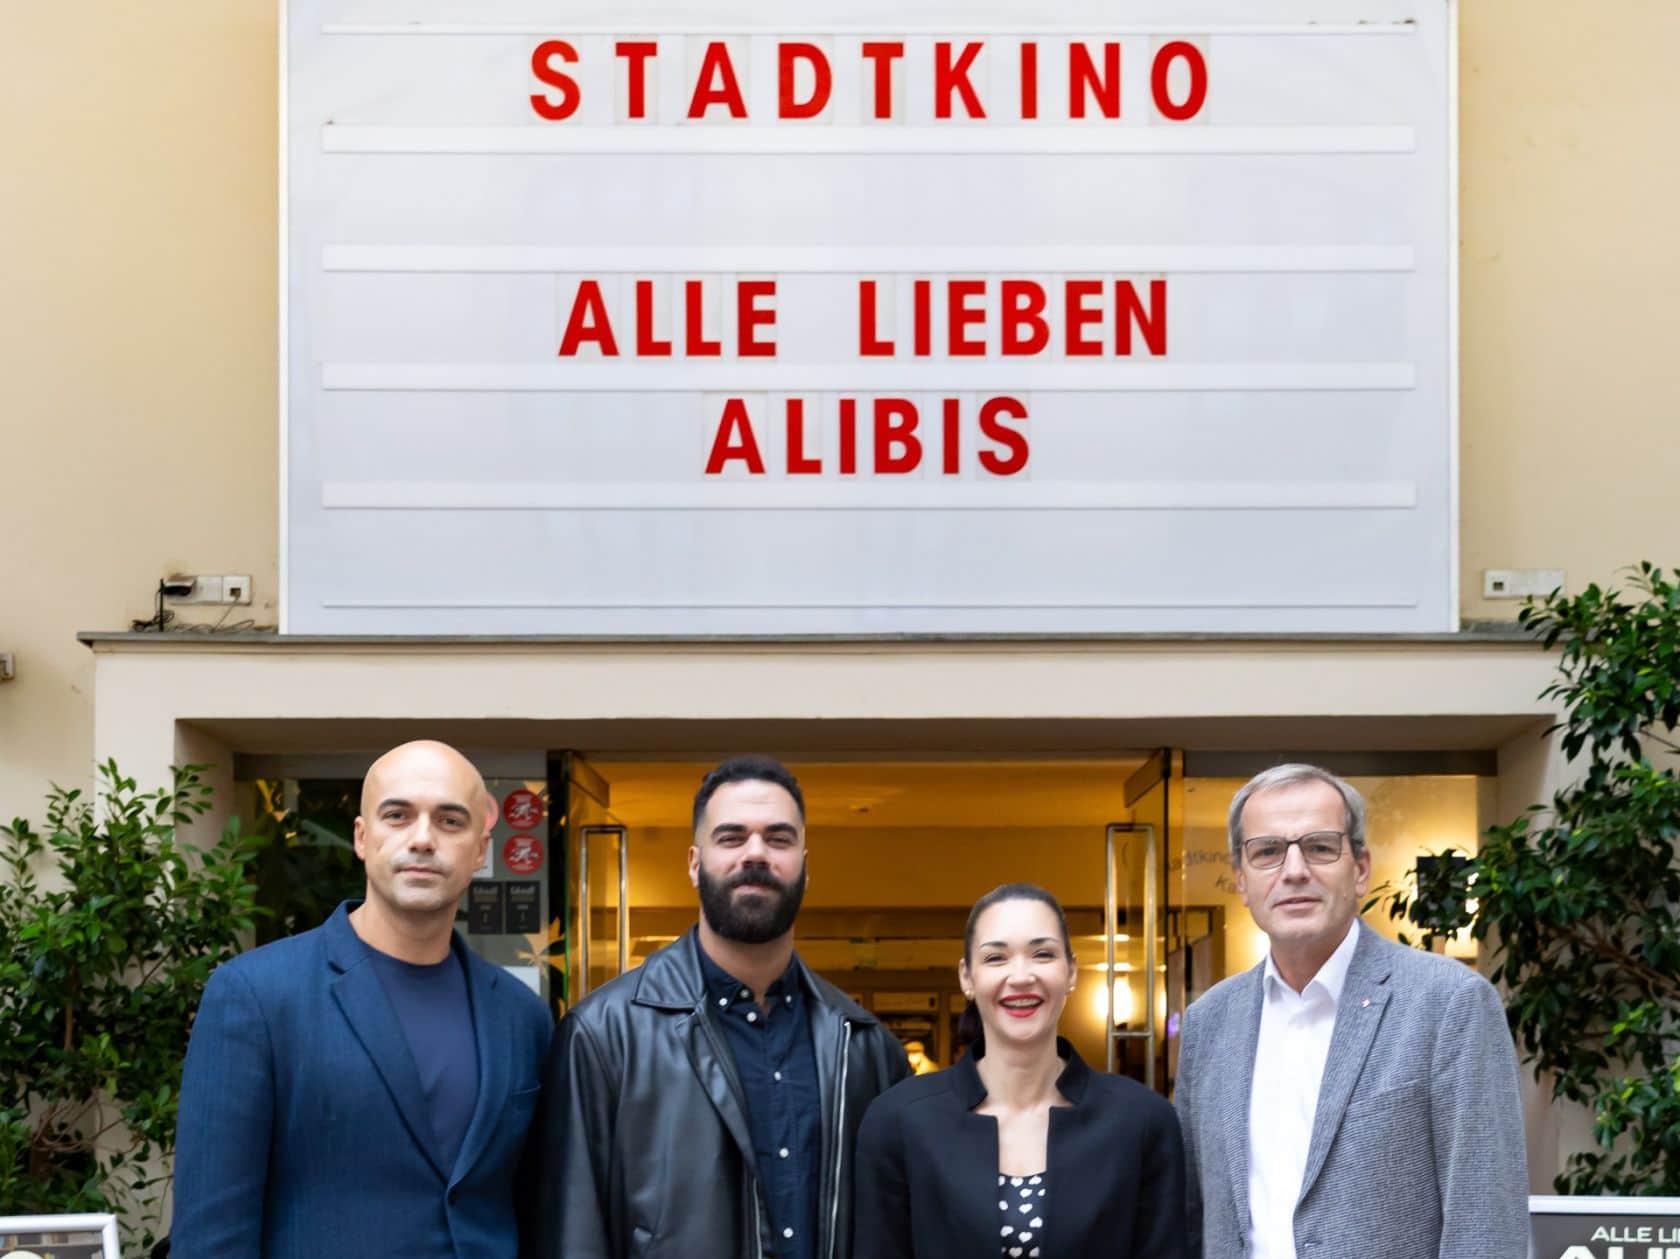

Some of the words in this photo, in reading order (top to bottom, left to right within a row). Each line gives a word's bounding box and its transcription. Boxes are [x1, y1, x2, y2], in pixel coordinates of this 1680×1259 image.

[530, 40, 1208, 121] STADTKINO
[559, 279, 777, 357] ALLE
[859, 279, 1168, 357] LIEBEN
[705, 396, 1030, 477] ALIBIS
[1590, 1226, 1653, 1242] ALLE
[1658, 1227, 1680, 1243] LI
